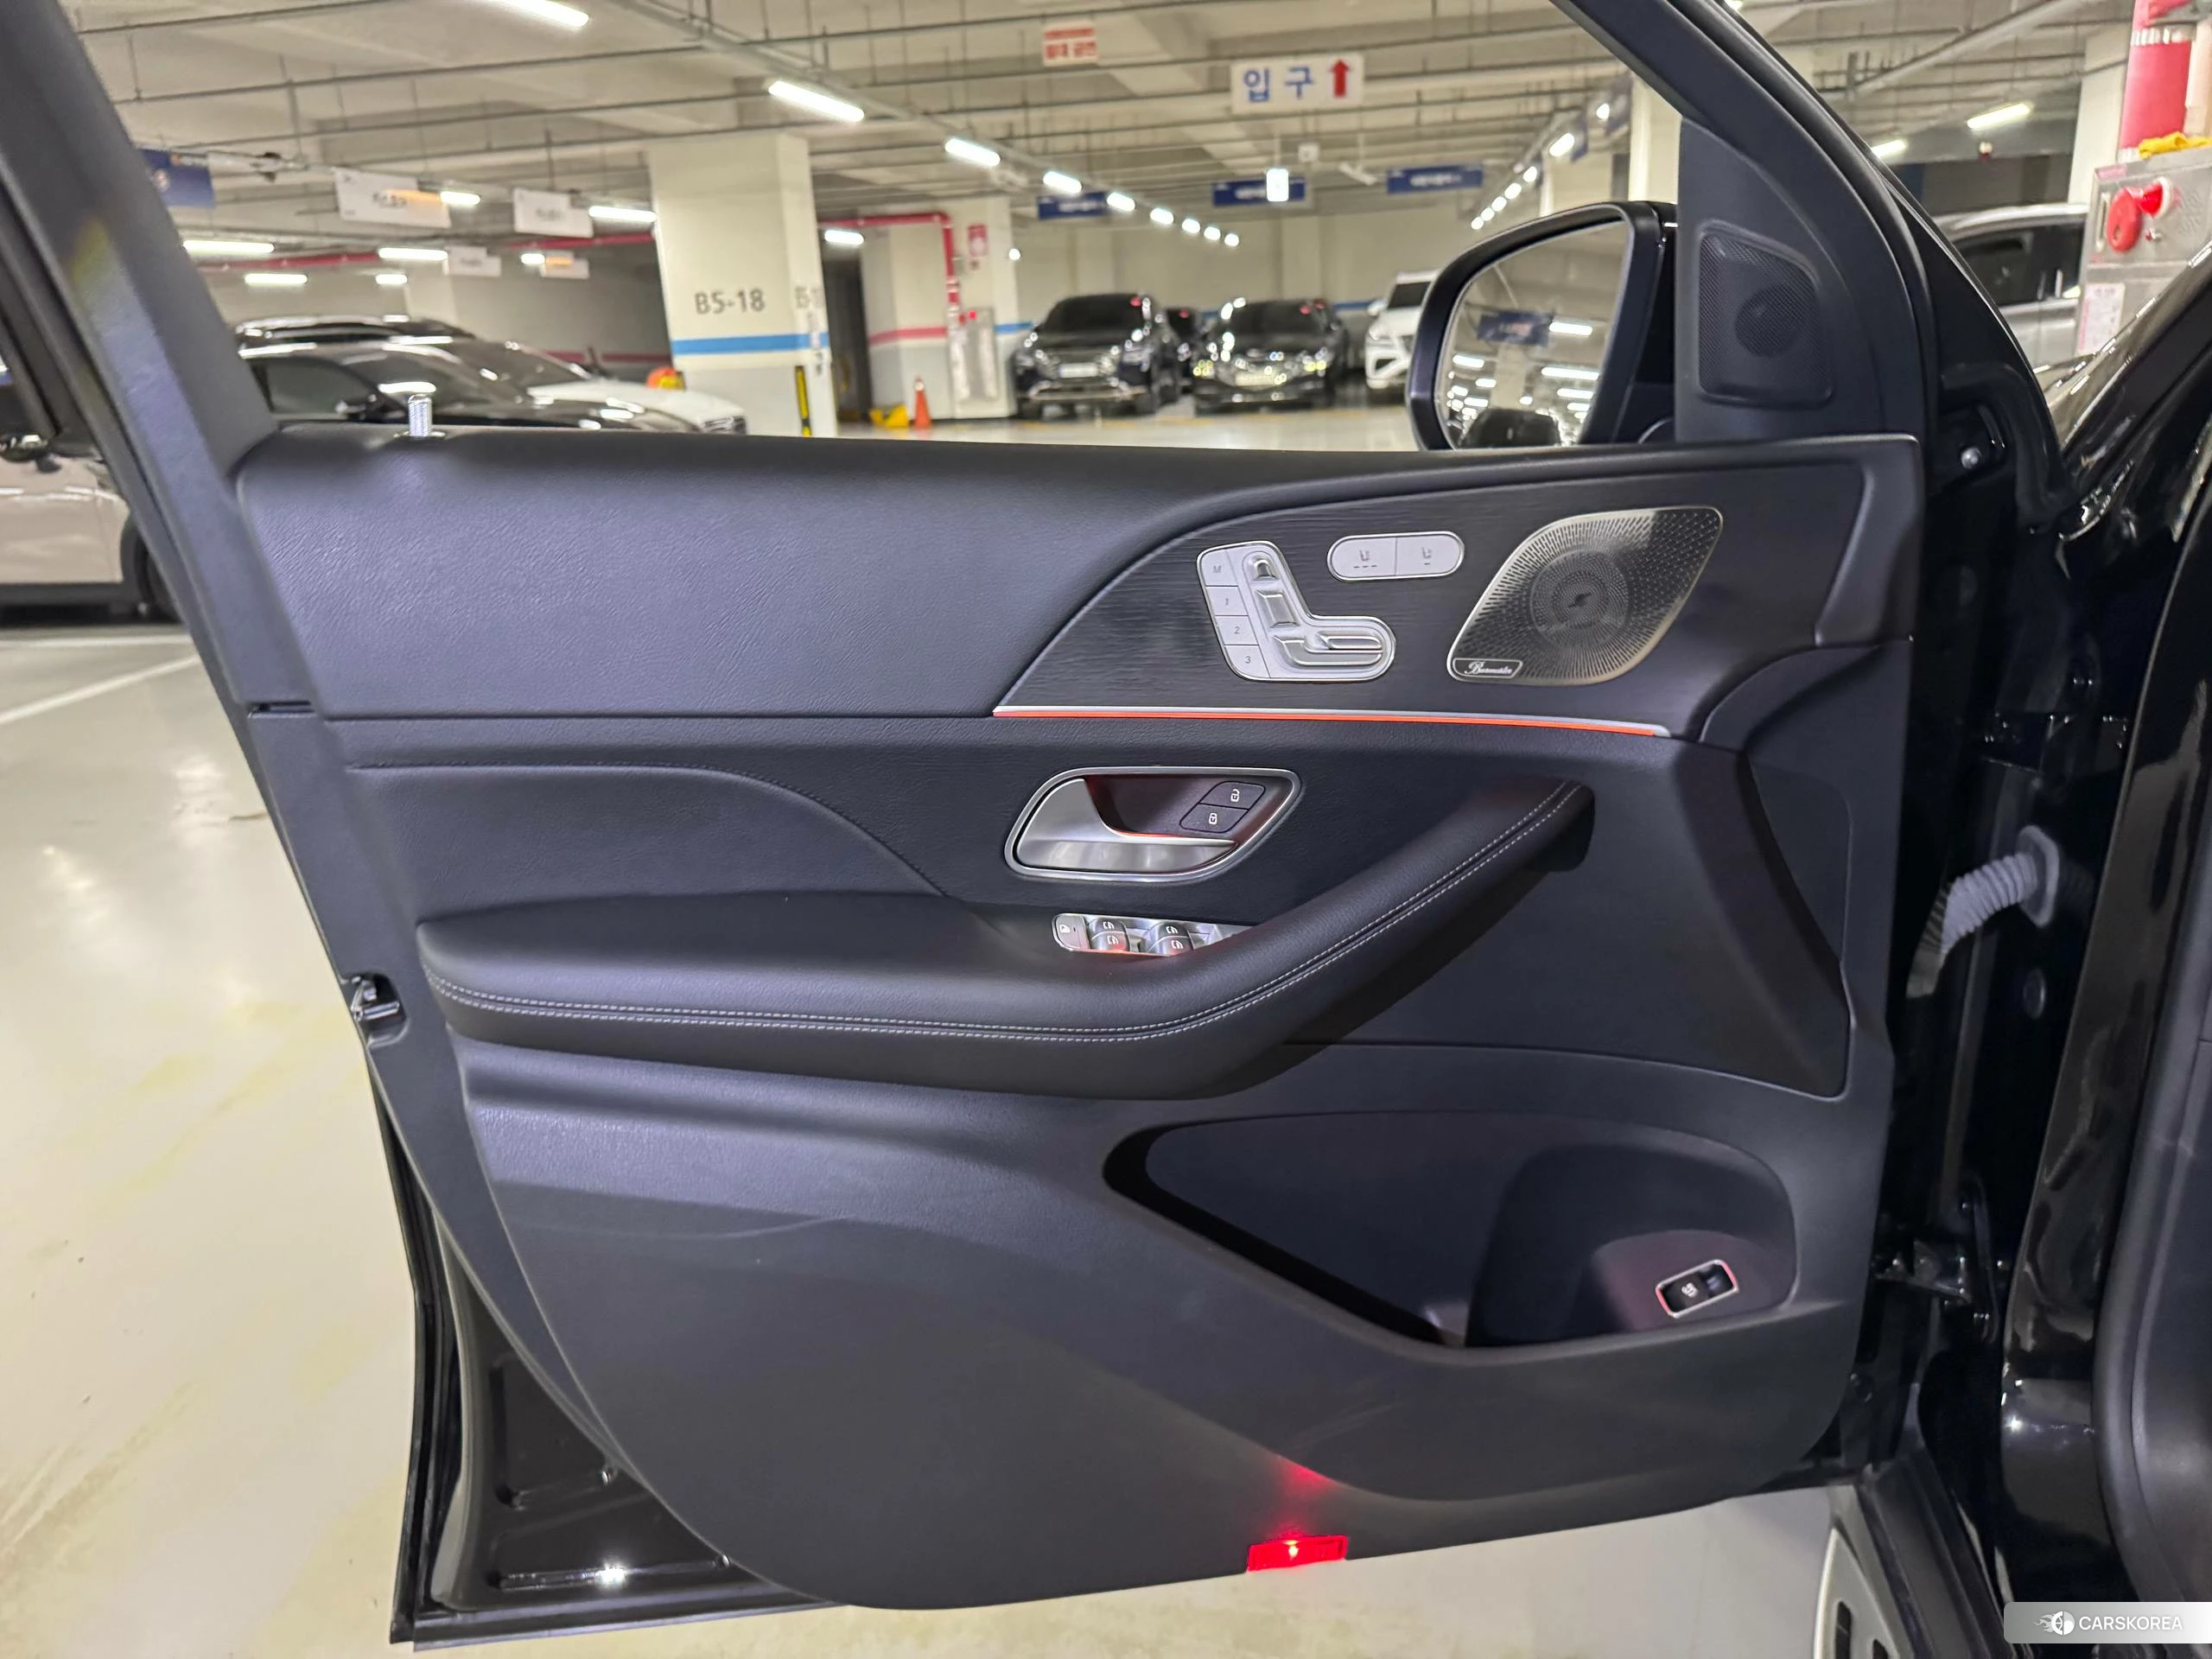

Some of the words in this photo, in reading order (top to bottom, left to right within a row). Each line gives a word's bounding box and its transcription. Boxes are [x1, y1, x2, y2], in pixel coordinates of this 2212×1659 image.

[694, 289, 766, 315] B5-18
[1212, 565, 1222, 574] M
[1234, 626, 1240, 635] 2
[1245, 656, 1251, 664] 3
